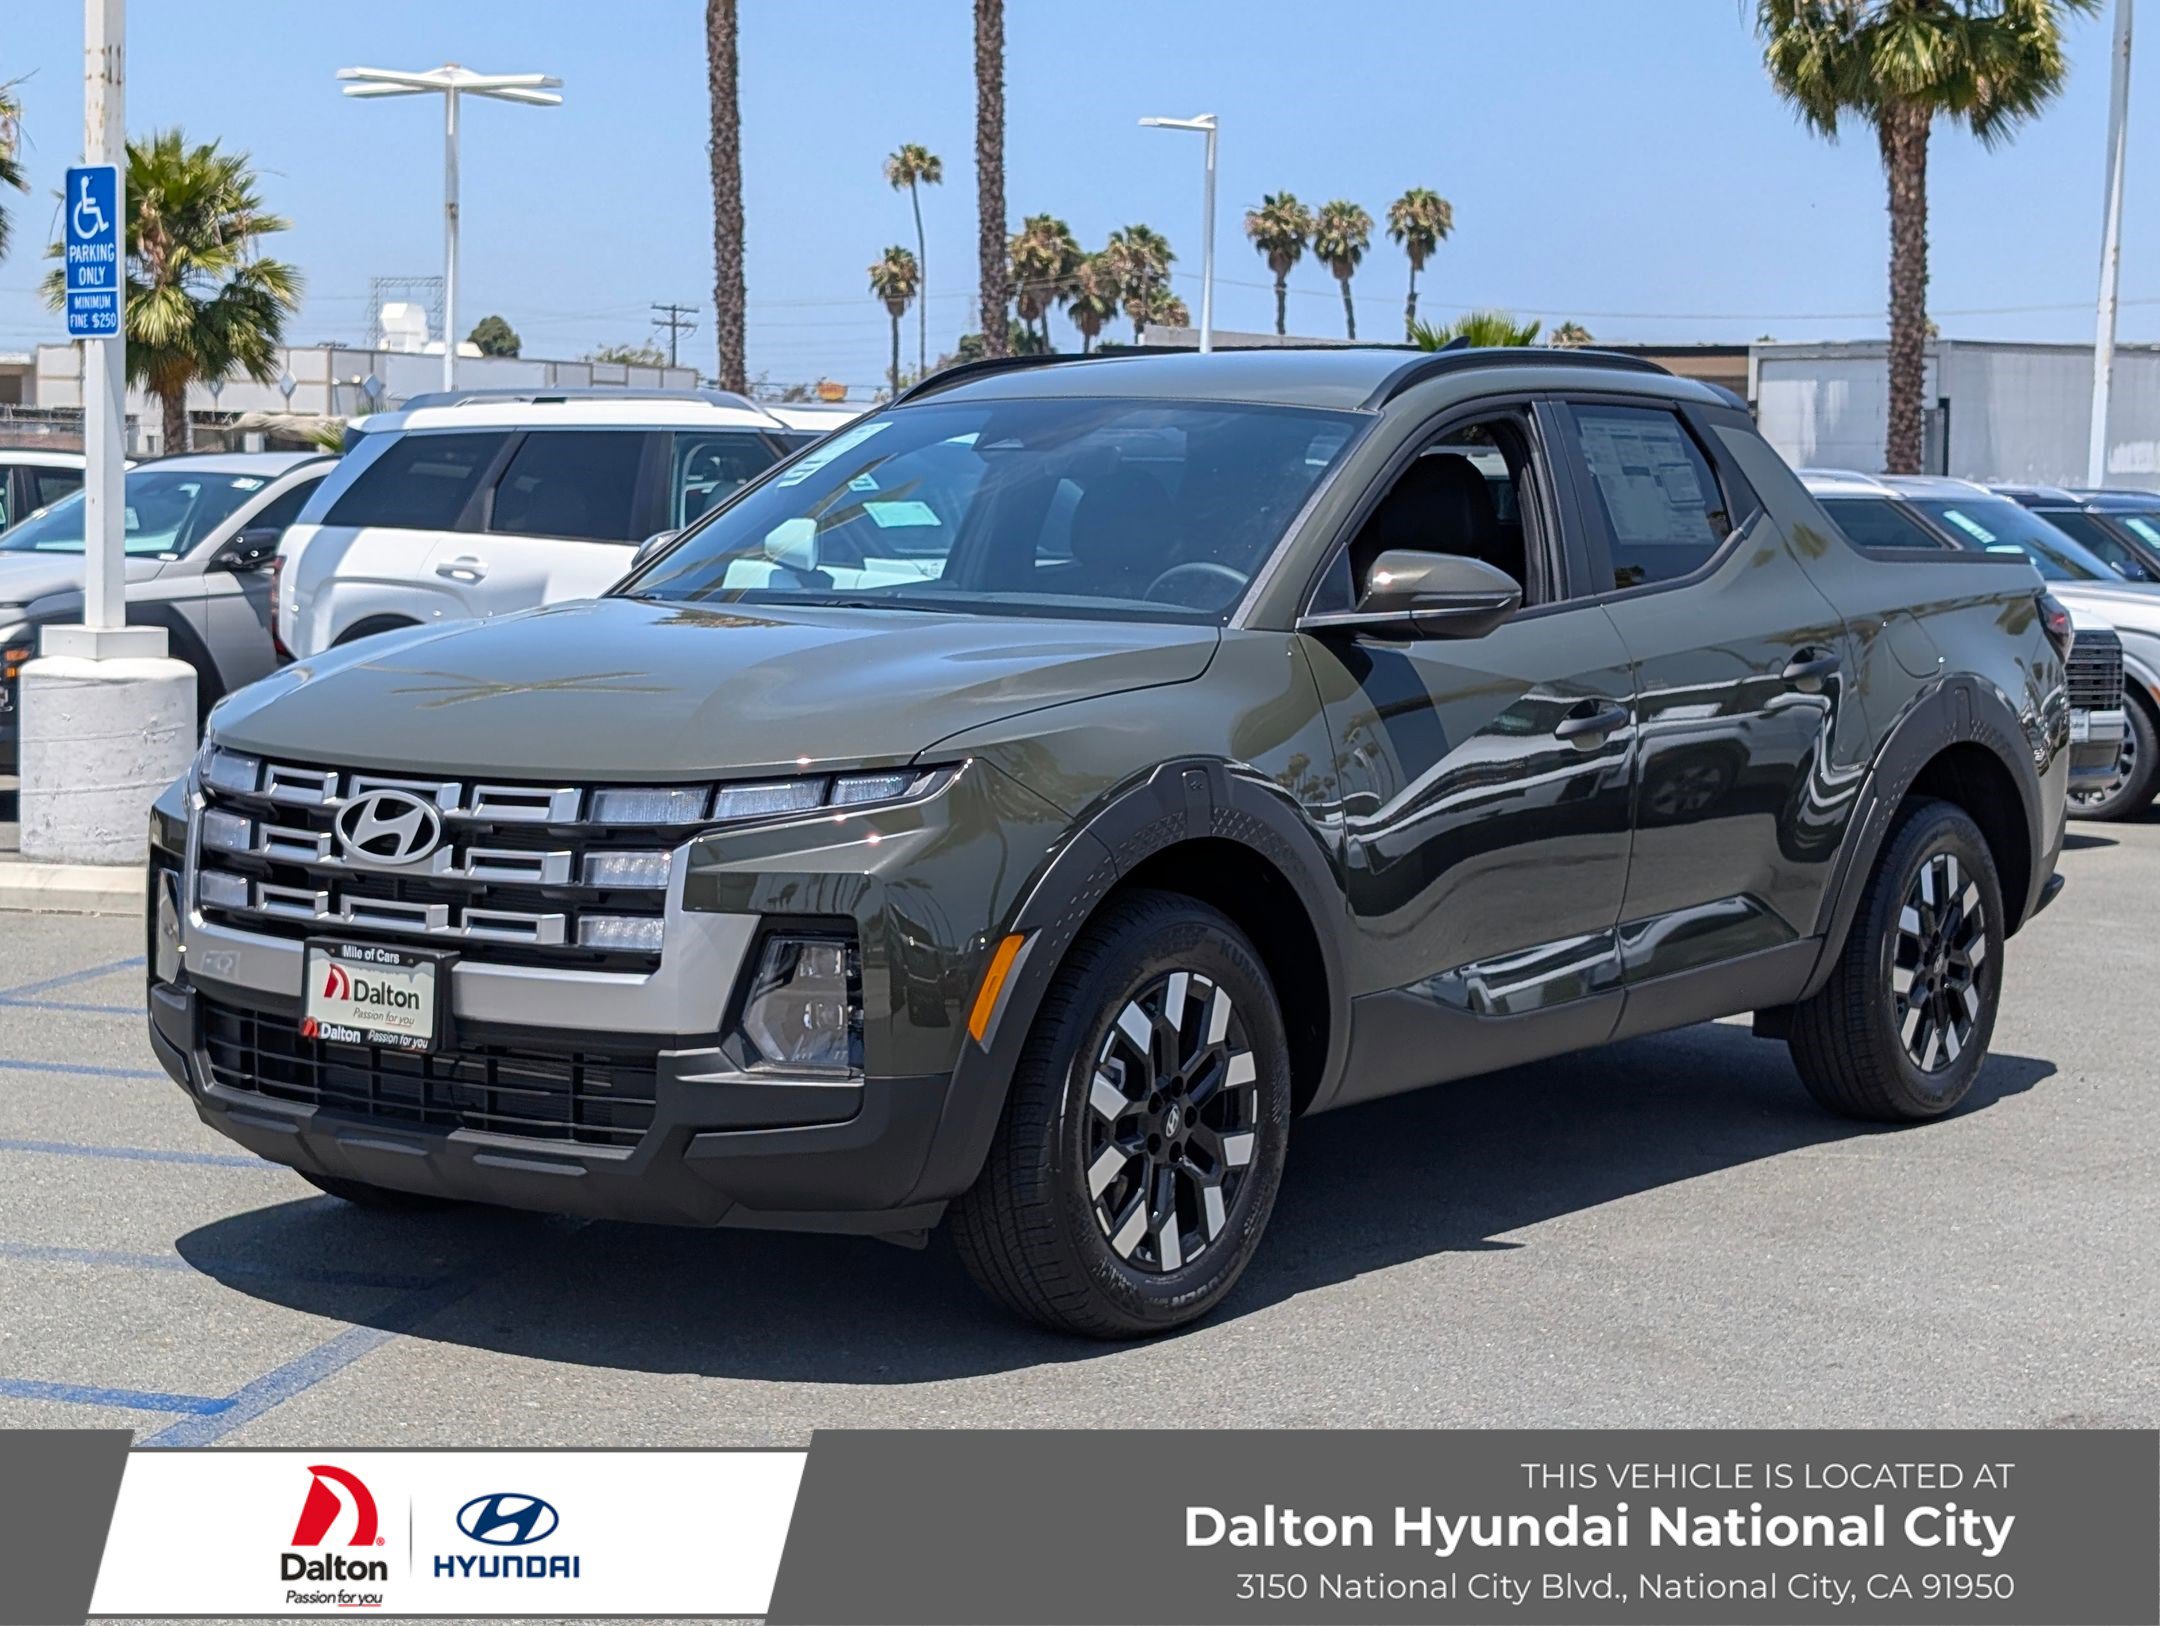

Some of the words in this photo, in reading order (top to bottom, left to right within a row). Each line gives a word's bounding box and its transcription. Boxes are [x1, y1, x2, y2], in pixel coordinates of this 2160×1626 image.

[69, 243, 115, 263] PARKING
[78, 266, 105, 286] ONLY
[74, 295, 111, 310] MINIMUM
[70, 313, 89, 328] FINE
[92, 311, 117, 329] $250
[342, 944, 363, 960] Mile
[364, 948, 376, 961] of
[377, 949, 400, 964] Cars
[353, 978, 420, 1010] Dalton
[353, 1007, 384, 1022] Passion
[385, 1011, 398, 1023] for
[399, 1014, 415, 1026] you
[320, 1023, 361, 1044] Dalton
[368, 1028, 398, 1045] Passion
[399, 1033, 413, 1047] for
[412, 1038, 429, 1050] you
